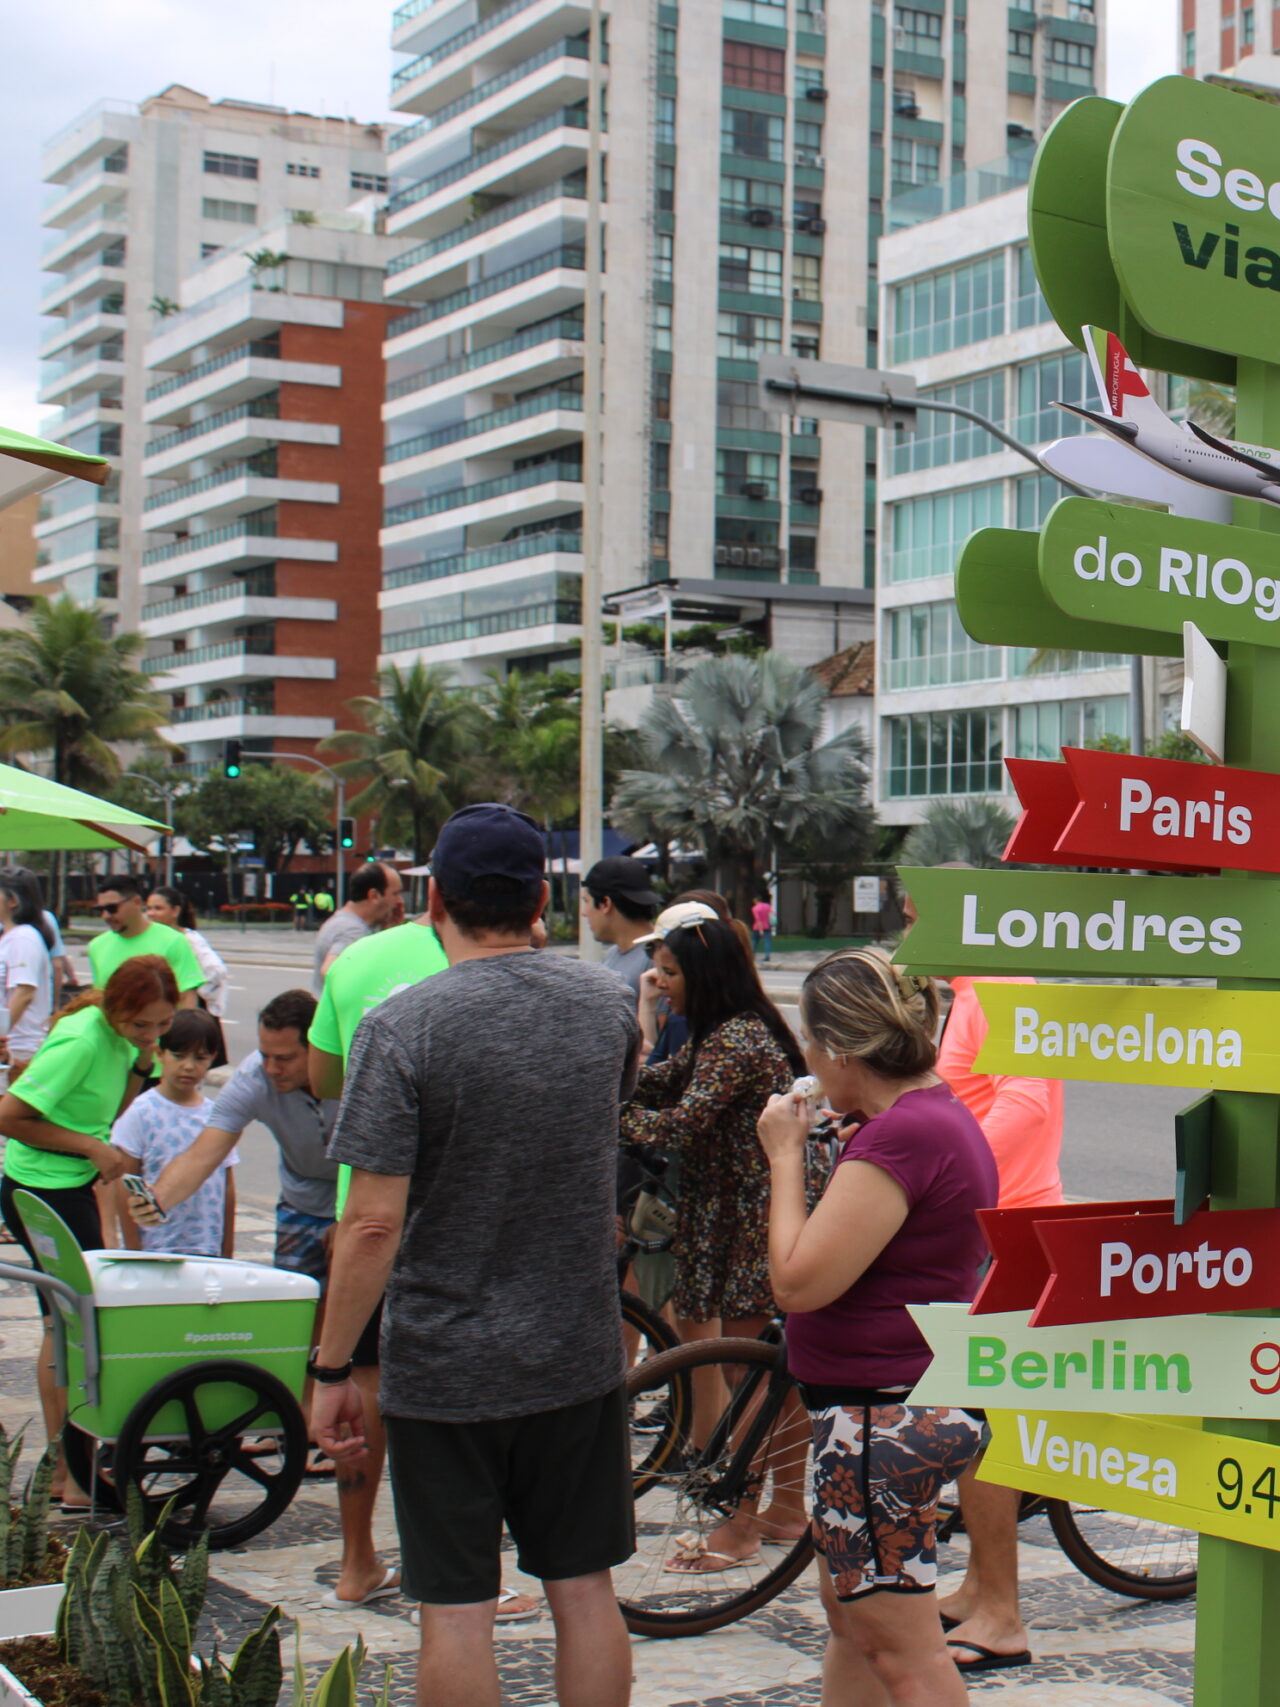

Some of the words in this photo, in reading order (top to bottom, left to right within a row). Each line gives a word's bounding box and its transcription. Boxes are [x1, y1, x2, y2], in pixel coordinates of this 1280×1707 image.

[1073, 536, 1142, 587] do
[1119, 778, 1252, 845] Paris
[961, 895, 1242, 956] Londres
[1013, 1007, 1242, 1068] Barcelona
[1100, 1241, 1252, 1297] Porto
[967, 1336, 1192, 1393] Berlim
[1016, 1415, 1177, 1498] Veneza
